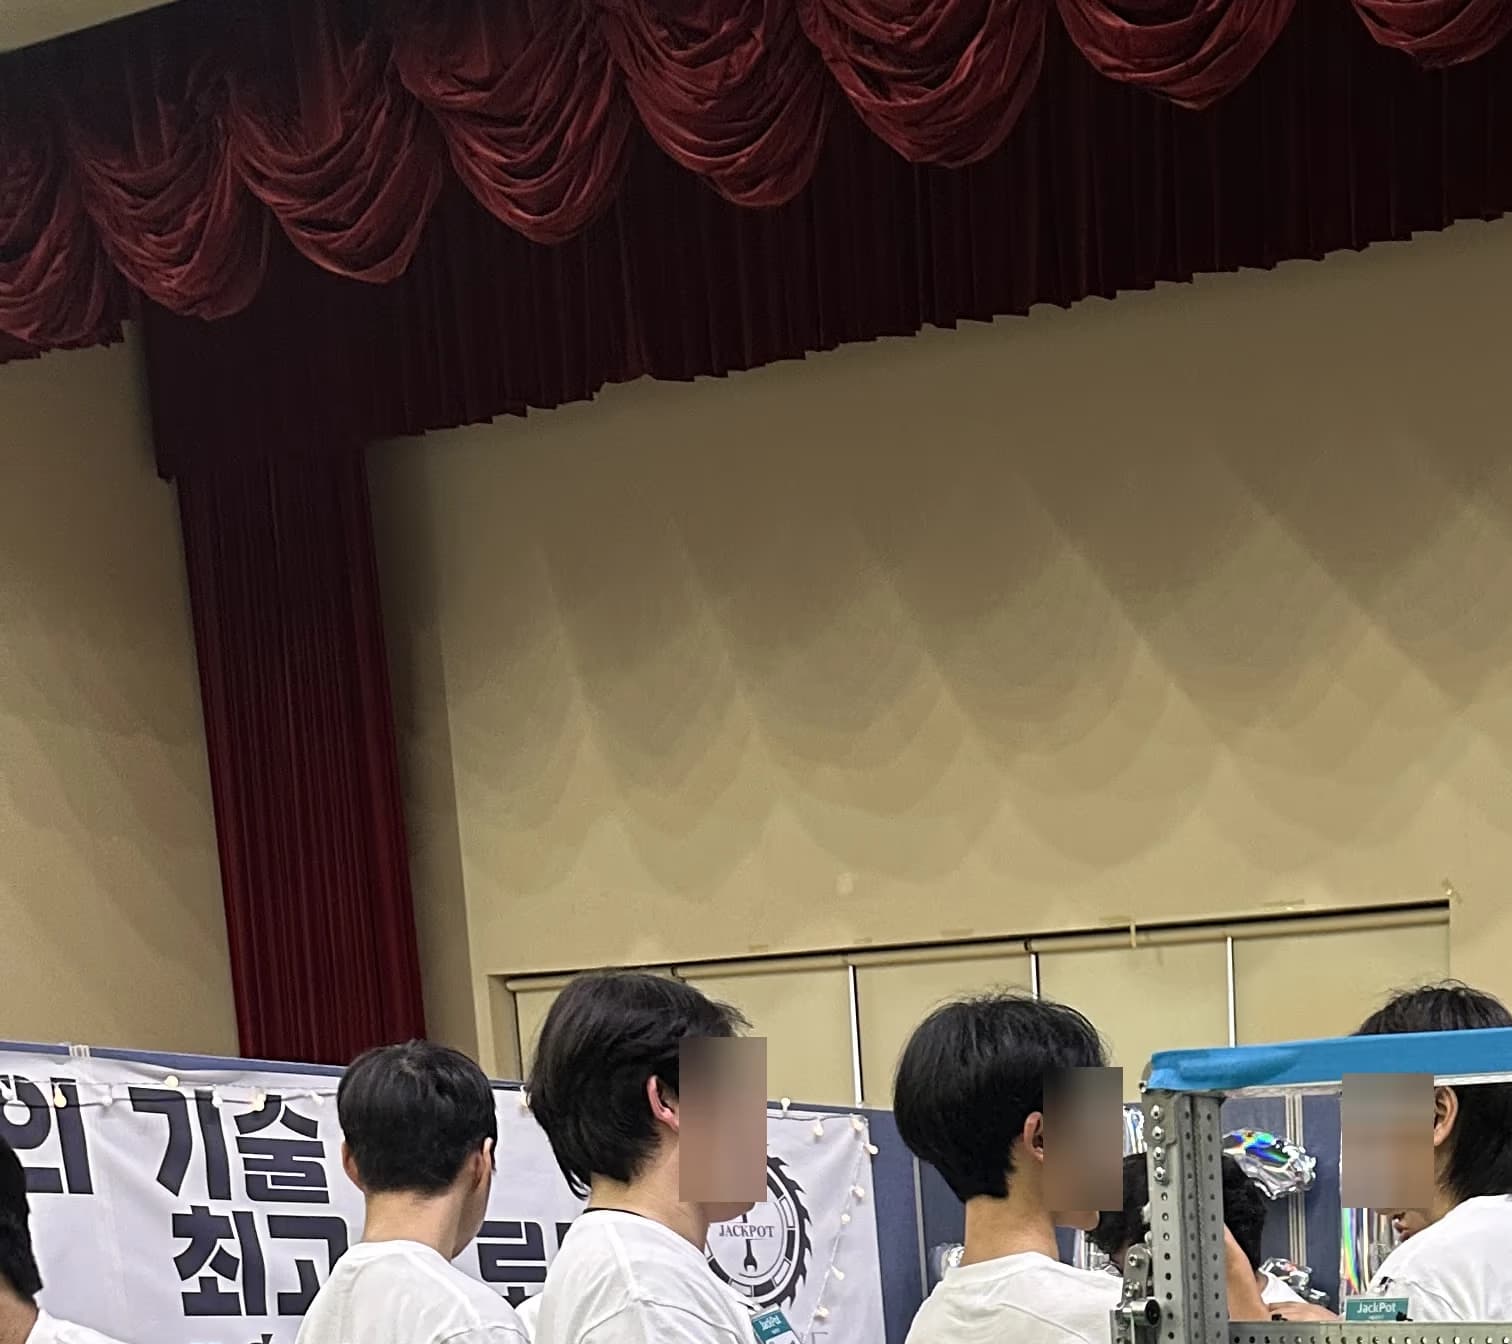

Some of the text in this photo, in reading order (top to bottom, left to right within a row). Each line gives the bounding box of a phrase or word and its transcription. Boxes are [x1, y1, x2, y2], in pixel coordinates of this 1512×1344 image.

[128, 1086, 330, 1204] 기술
[719, 1225, 775, 1239] JACKPOT
[1357, 1302, 1396, 1313] JackPot
